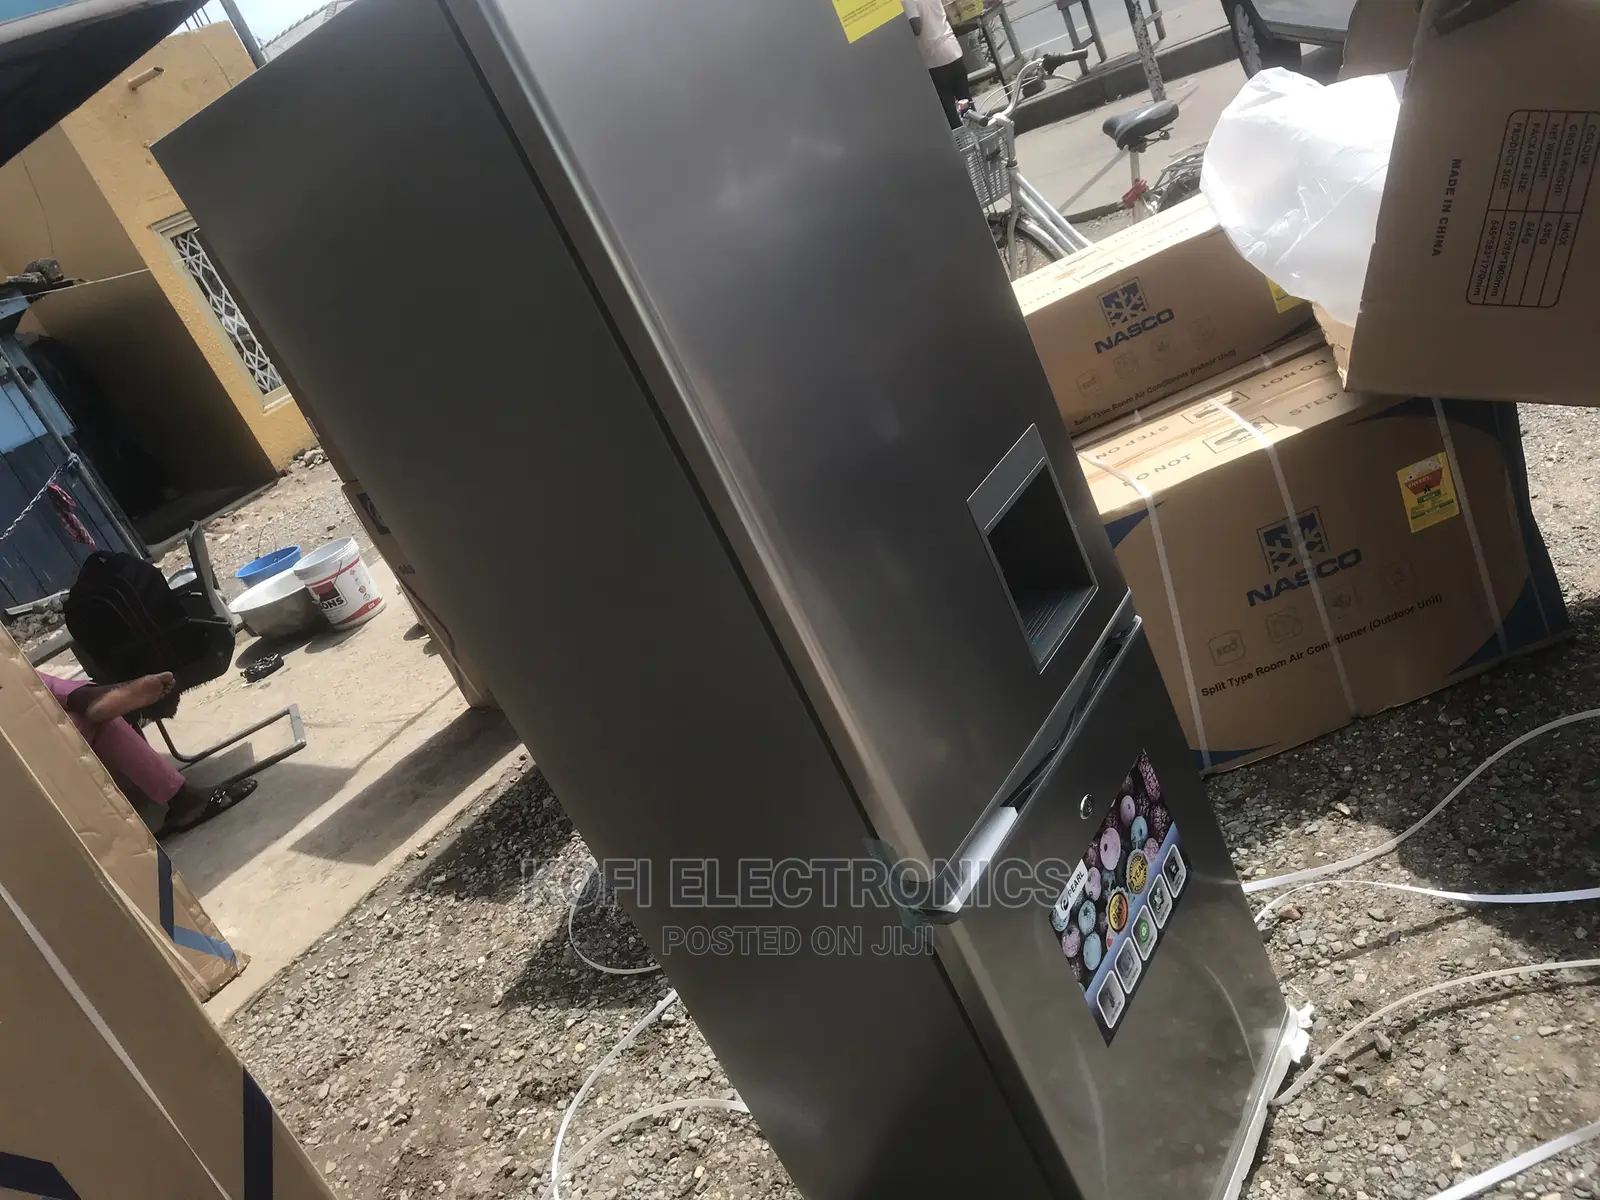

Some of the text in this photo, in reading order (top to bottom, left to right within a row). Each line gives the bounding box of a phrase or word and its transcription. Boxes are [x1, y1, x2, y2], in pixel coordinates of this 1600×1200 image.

[1505, 121, 1523, 168] PRODUCT
[1524, 122, 1541, 169] PACKAGE
[1432, 158, 1462, 257] MADE IN CHINA
[1558, 221, 1573, 247] INOX
[1094, 308, 1175, 354] NASCO
[1095, 359, 1327, 459] DO NOT STEP ON
[1112, 397, 1134, 411] Room
[1134, 391, 1145, 402] Air
[1146, 371, 1189, 394] Conditioner
[1154, 453, 1193, 473] NOT
[1289, 392, 1338, 416] STEP
[1246, 548, 1362, 607] NASCO
[1201, 681, 1227, 697] Split
[1227, 671, 1254, 687] Type
[1255, 660, 1287, 677] Room
[1289, 651, 1304, 664] Air
[1369, 605, 1415, 632] (Outdoor
[1417, 593, 1444, 610] Unit)
[1067, 870, 1085, 898] PEARL
